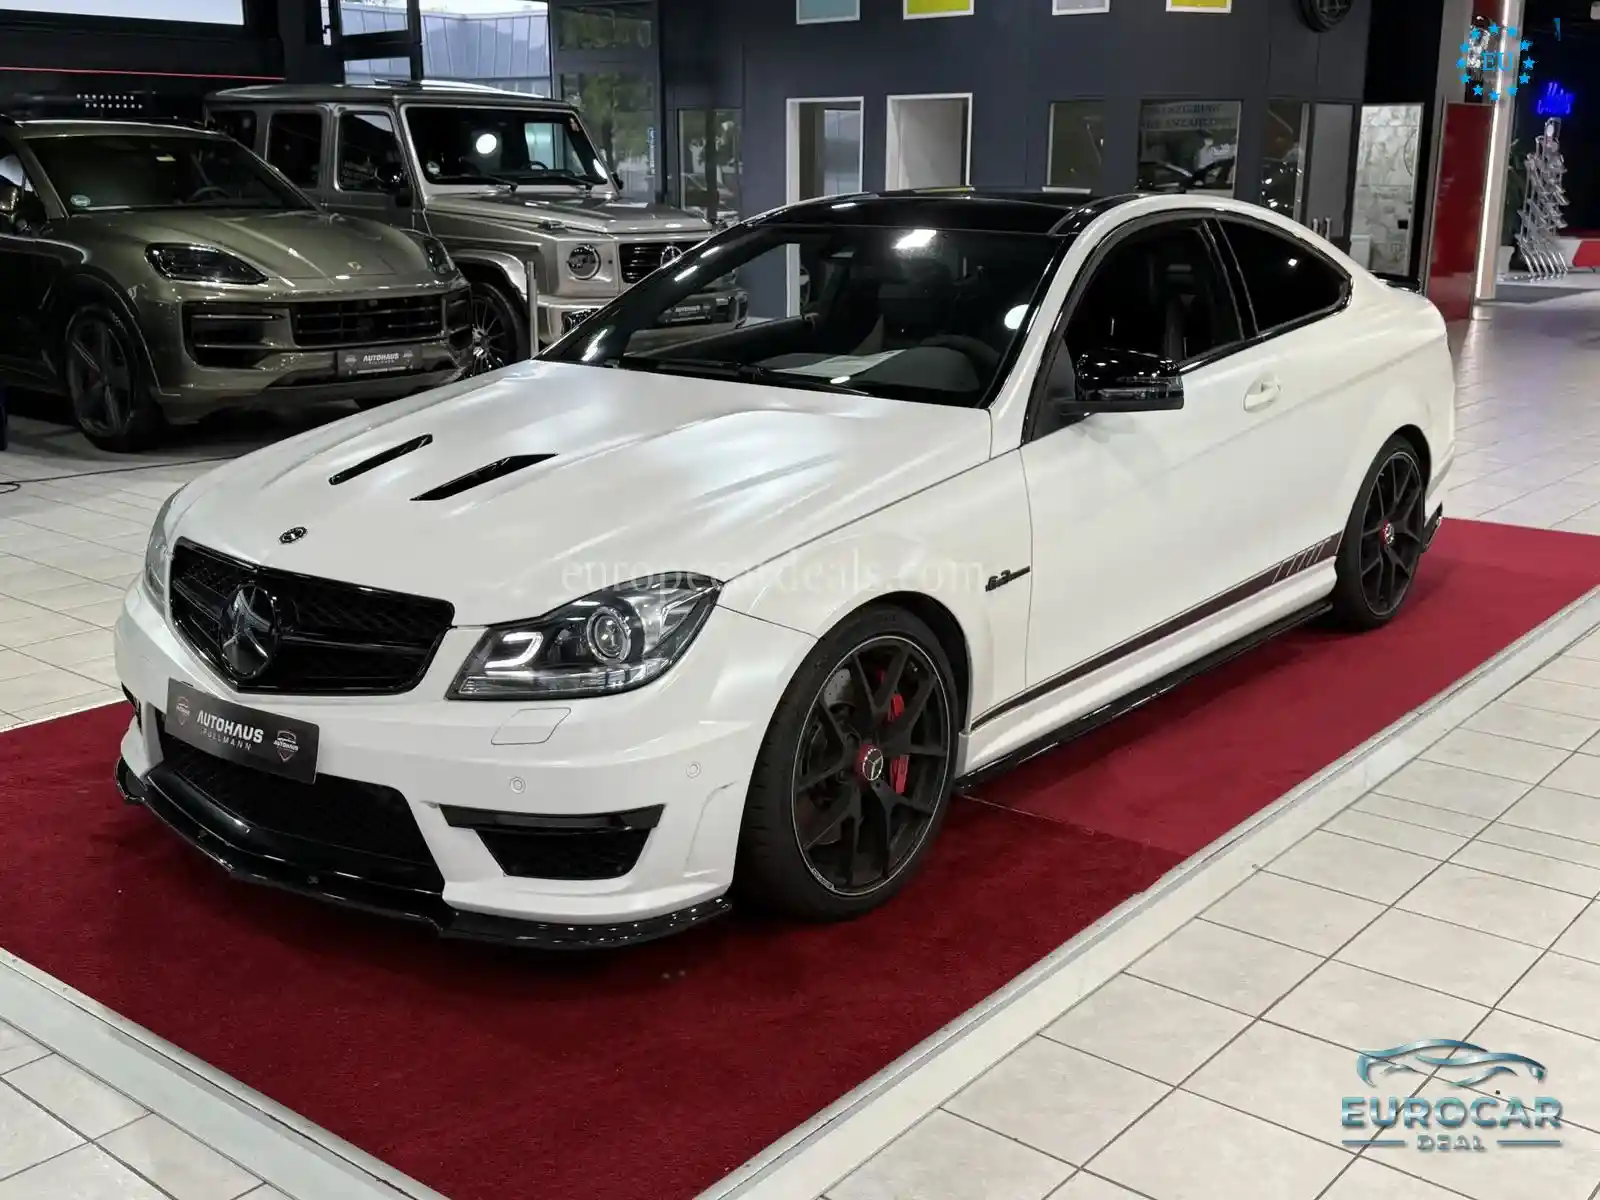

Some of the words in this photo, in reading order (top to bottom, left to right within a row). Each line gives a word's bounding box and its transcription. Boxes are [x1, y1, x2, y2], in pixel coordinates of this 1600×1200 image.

[363, 352, 399, 362] AUTOHAUS
[196, 710, 264, 743] AUTOHAUS
[202, 728, 252, 751] PULLMANN
